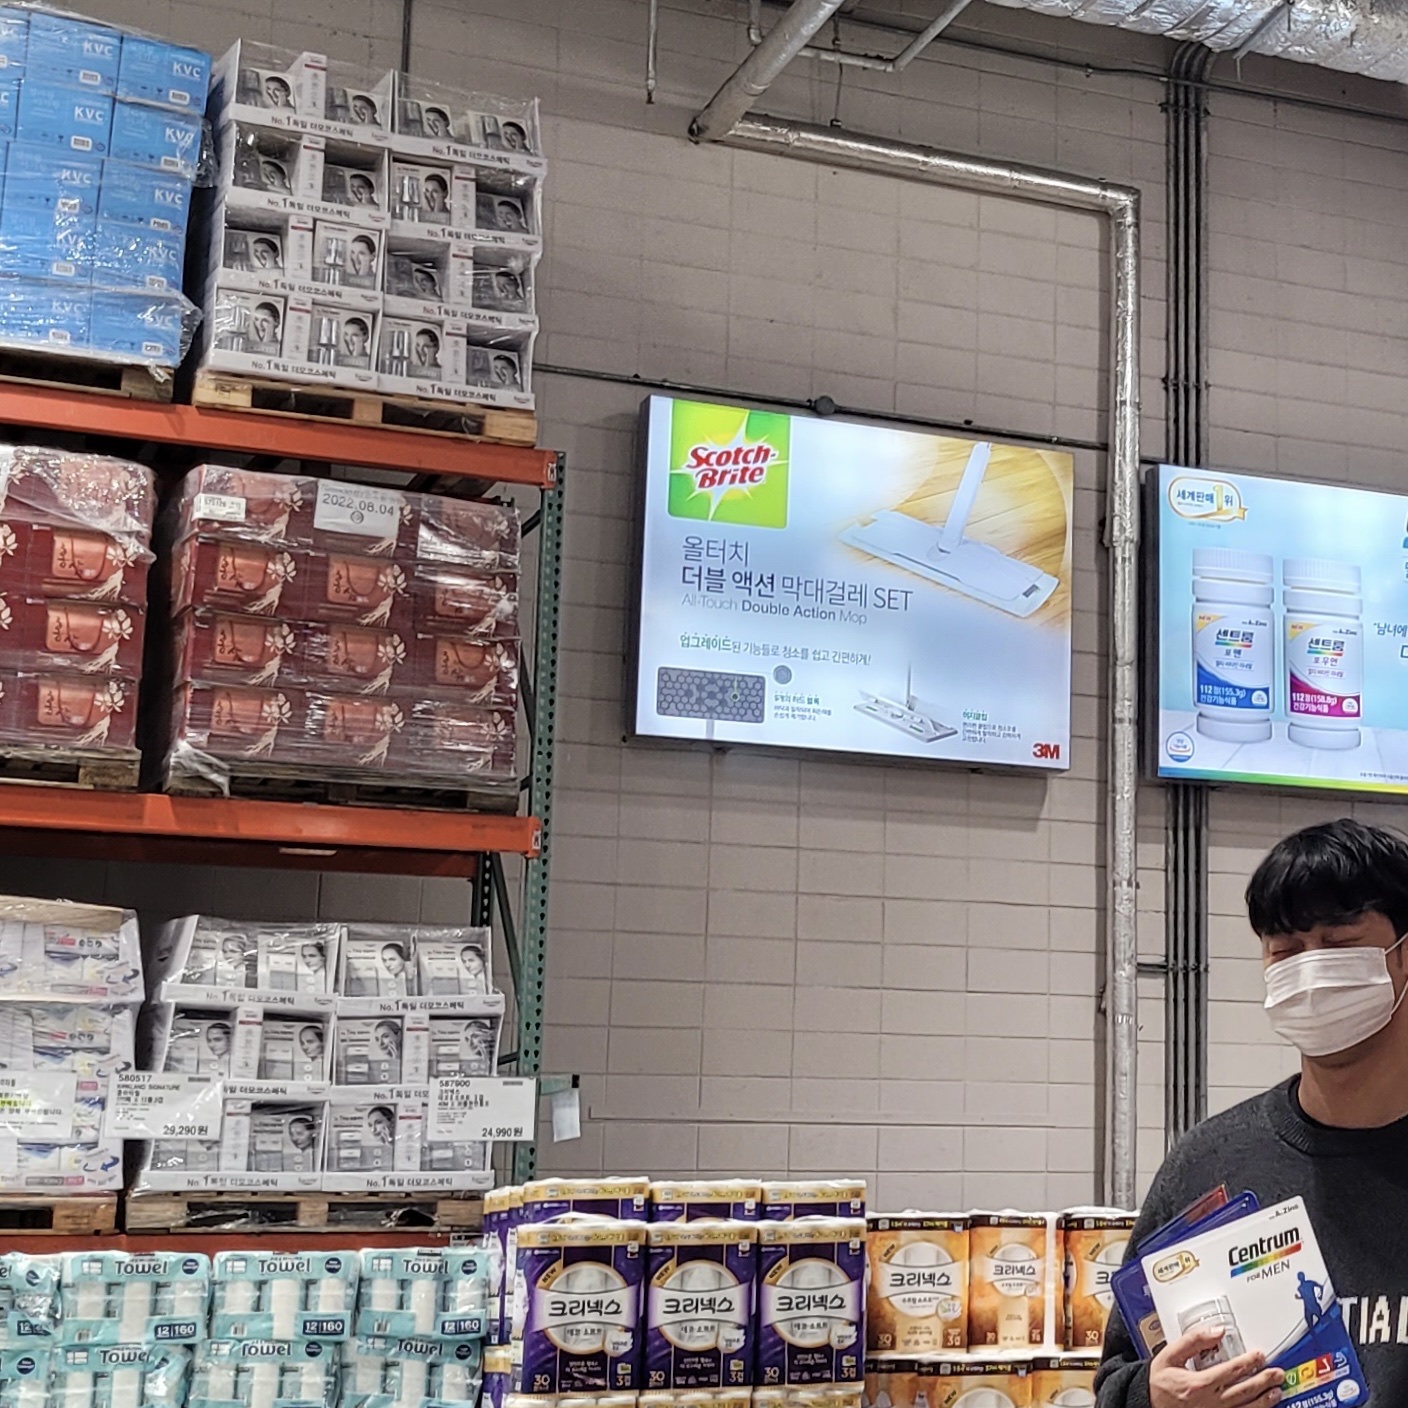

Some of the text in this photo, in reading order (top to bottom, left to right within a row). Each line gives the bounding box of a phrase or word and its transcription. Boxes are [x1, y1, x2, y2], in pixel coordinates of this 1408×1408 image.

[83, 39, 114, 59] KVC
[172, 60, 202, 78] KVC
[74, 105, 104, 124] KVC
[60, 167, 91, 186] KVC
[153, 187, 183, 206] KVC
[686, 444, 778, 470] Scotch-
[697, 464, 764, 490] Brite
[322, 493, 395, 516] 2022.08.04
[681, 535, 750, 567] 올터치
[680, 565, 914, 612] 더블 액션 막대걸레 SET
[741, 598, 790, 617] Double
[793, 602, 836, 622] Action
[839, 608, 868, 626] Mop
[679, 632, 872, 666] 업그레이드된 기능들로 청소를 쉽고 간편하게!
[1032, 742, 1060, 760] 3M
[118, 1074, 152, 1083] 580517
[162, 1125, 209, 1136] 29,290원
[481, 1126, 523, 1138] 24,990원
[1228, 1226, 1300, 1267] Centrum
[114, 1261, 169, 1275] Towel
[258, 1259, 311, 1274] Towel
[403, 1259, 449, 1274] Towel
[992, 1264, 1037, 1277] 크리넥스
[1261, 1259, 1290, 1280] MEN
[889, 1272, 953, 1288] 크리넥스
[548, 1298, 623, 1318] 크리넥스
[662, 1296, 735, 1315] 크리넥스
[775, 1294, 847, 1313] 크리넥스
[241, 1342, 292, 1357] Towel
[398, 1338, 443, 1355] Towel
[533, 1374, 550, 1386] 30
[648, 1370, 665, 1382] 30
[764, 1366, 780, 1378] 30
